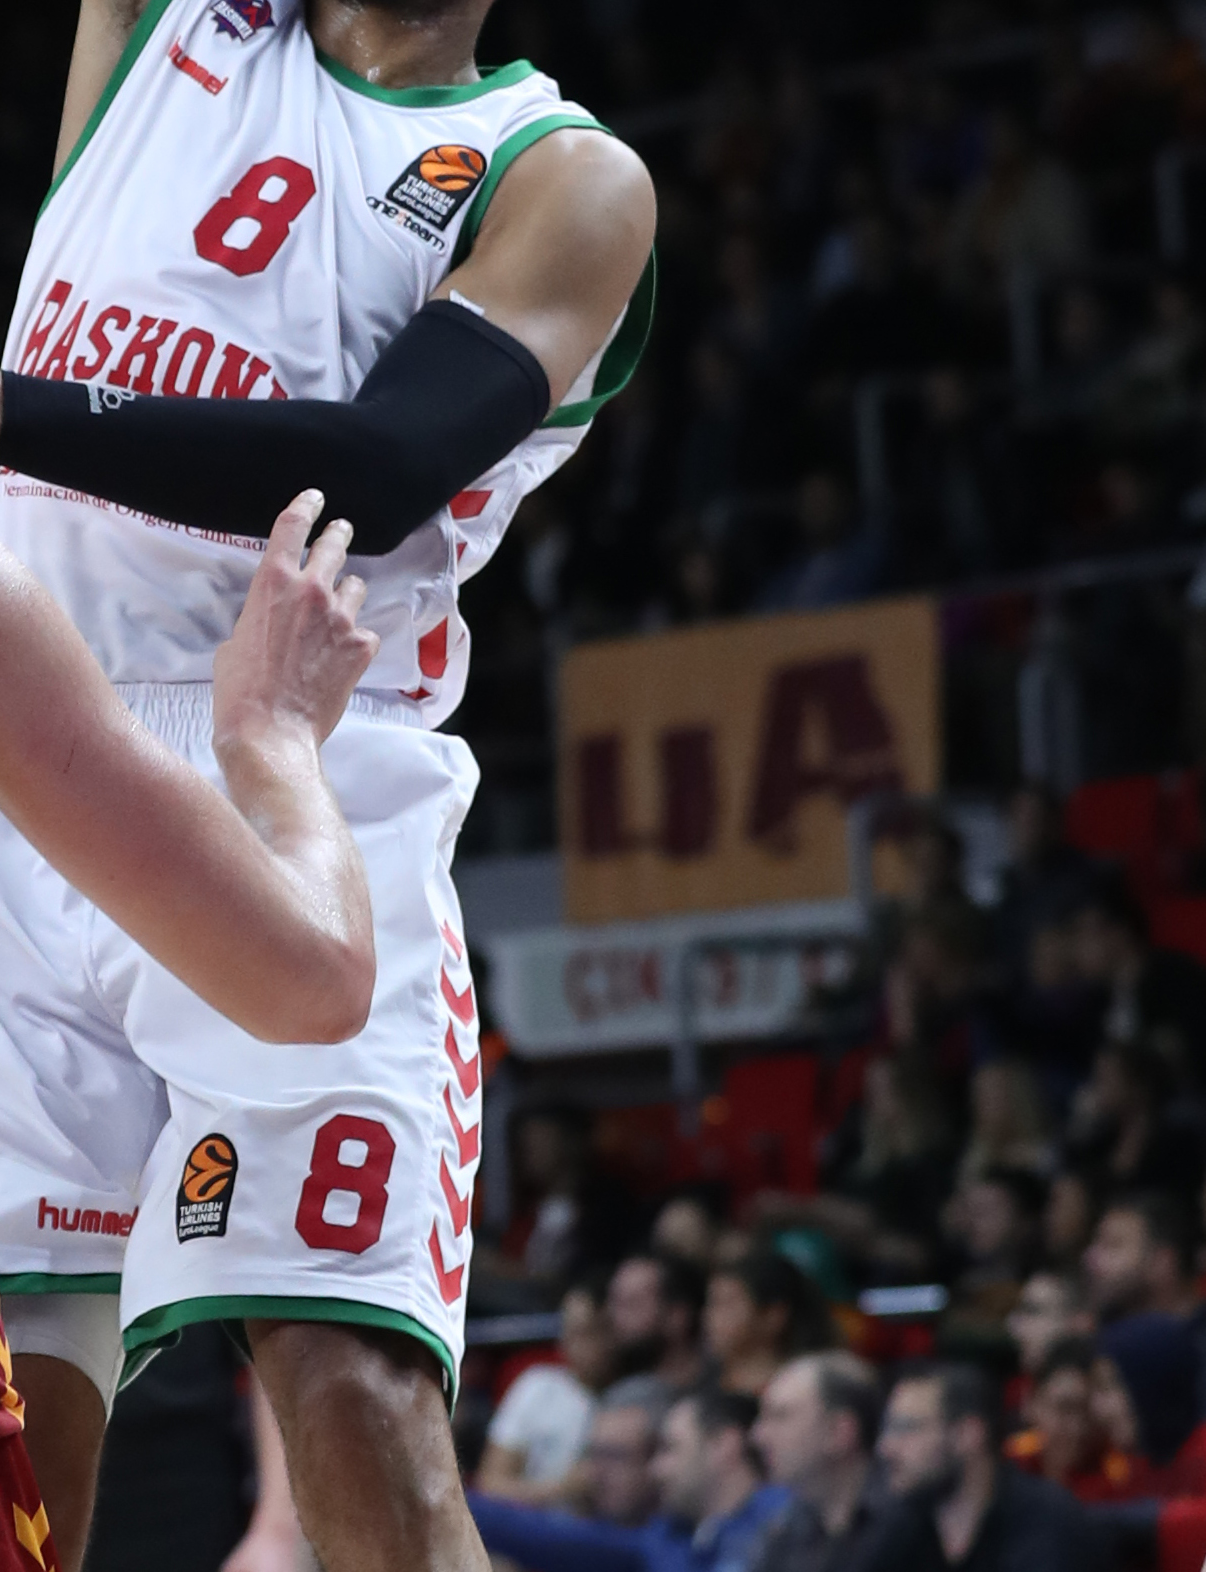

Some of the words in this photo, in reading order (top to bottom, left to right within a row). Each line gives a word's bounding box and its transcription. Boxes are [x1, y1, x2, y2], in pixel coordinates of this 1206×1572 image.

[398, 182, 449, 216] AIRLINES
[406, 174, 456, 208] TURKISH
[192, 155, 317, 277] 8
[17, 279, 288, 400] BASKON
[294, 1113, 397, 1255] 8
[179, 1212, 221, 1227] AIRLINES
[180, 1201, 224, 1217] TURKISH
